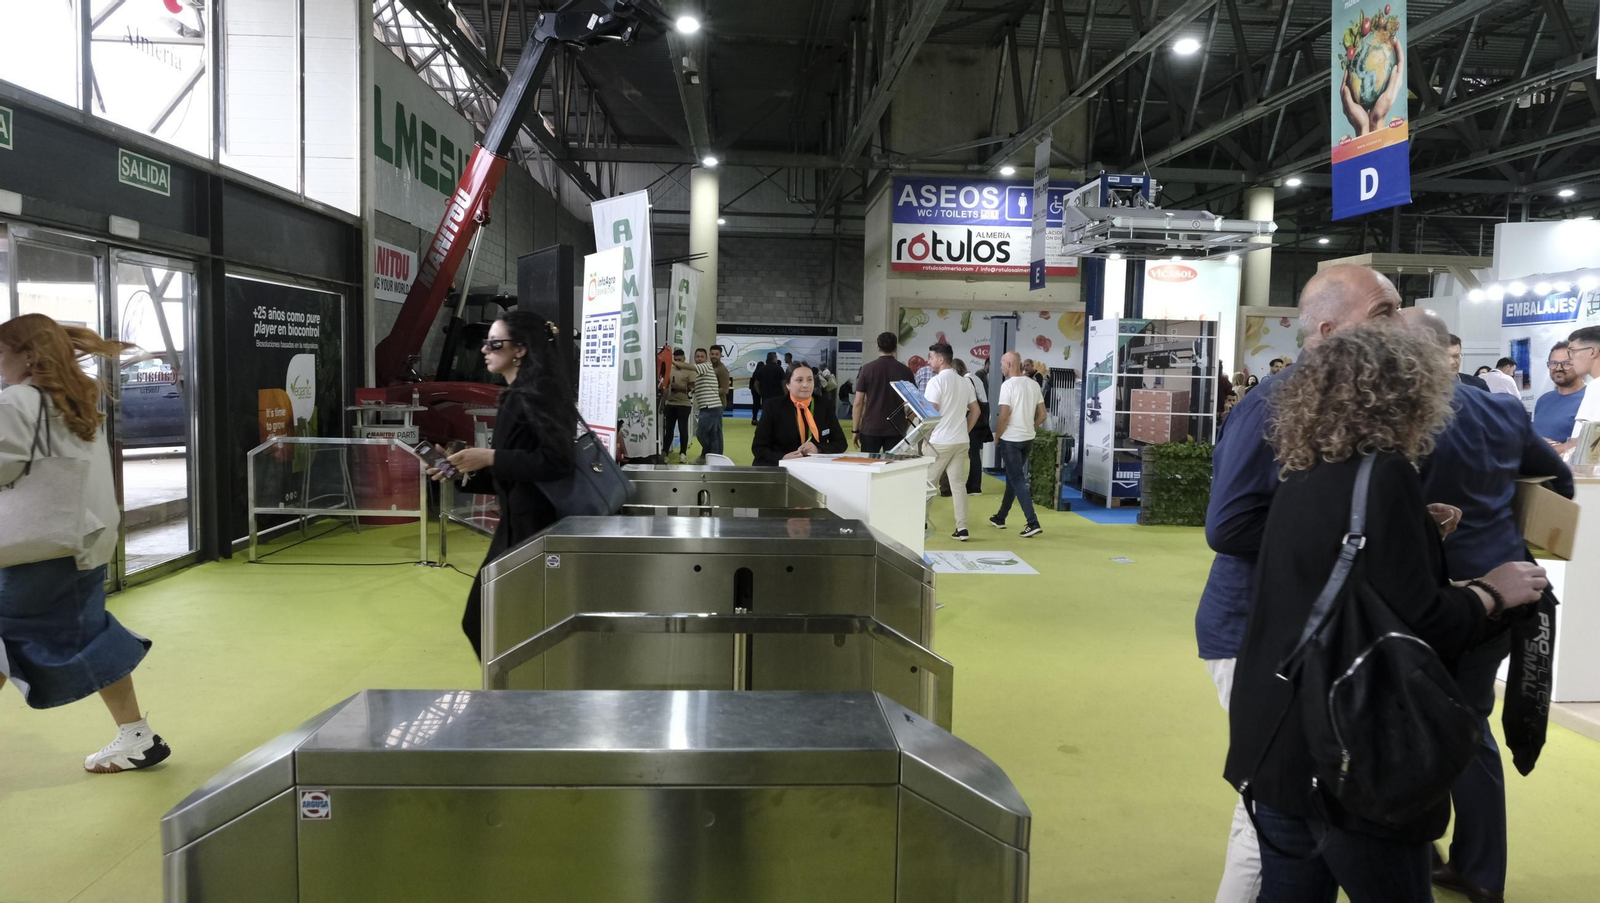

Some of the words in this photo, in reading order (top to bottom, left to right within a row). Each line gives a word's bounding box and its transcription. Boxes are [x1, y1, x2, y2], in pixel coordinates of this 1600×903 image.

[121, 155, 168, 188] SALIDA
[1360, 167, 1379, 201] D
[897, 184, 999, 210] ASEOS
[917, 208, 932, 217] WC
[941, 209, 979, 218] TOILETS
[419, 187, 472, 290] MANITOU
[975, 230, 1011, 240] ALMERÍA
[896, 228, 1011, 263] rótulos
[1150, 268, 1196, 279] VICASOL
[381, 278, 394, 292] YOUR
[394, 282, 410, 294] WORLD
[1505, 297, 1578, 318] EMBALAJES
[253, 306, 266, 319] +25
[268, 307, 286, 321] años
[286, 311, 305, 323] como
[305, 313, 321, 327] pure
[673, 278, 690, 354] ALME
[254, 321, 277, 338] player
[278, 324, 287, 335] en
[288, 323, 320, 338] biocontrol
[736, 326, 776, 335] ENLAZANDO
[777, 327, 805, 335] VALORES
[265, 408, 275, 418] It's
[275, 408, 286, 417] time
[266, 422, 272, 431] to
[272, 423, 285, 432] grow
[397, 431, 416, 439] PARTS
[302, 800, 329, 808] ARGUSA
